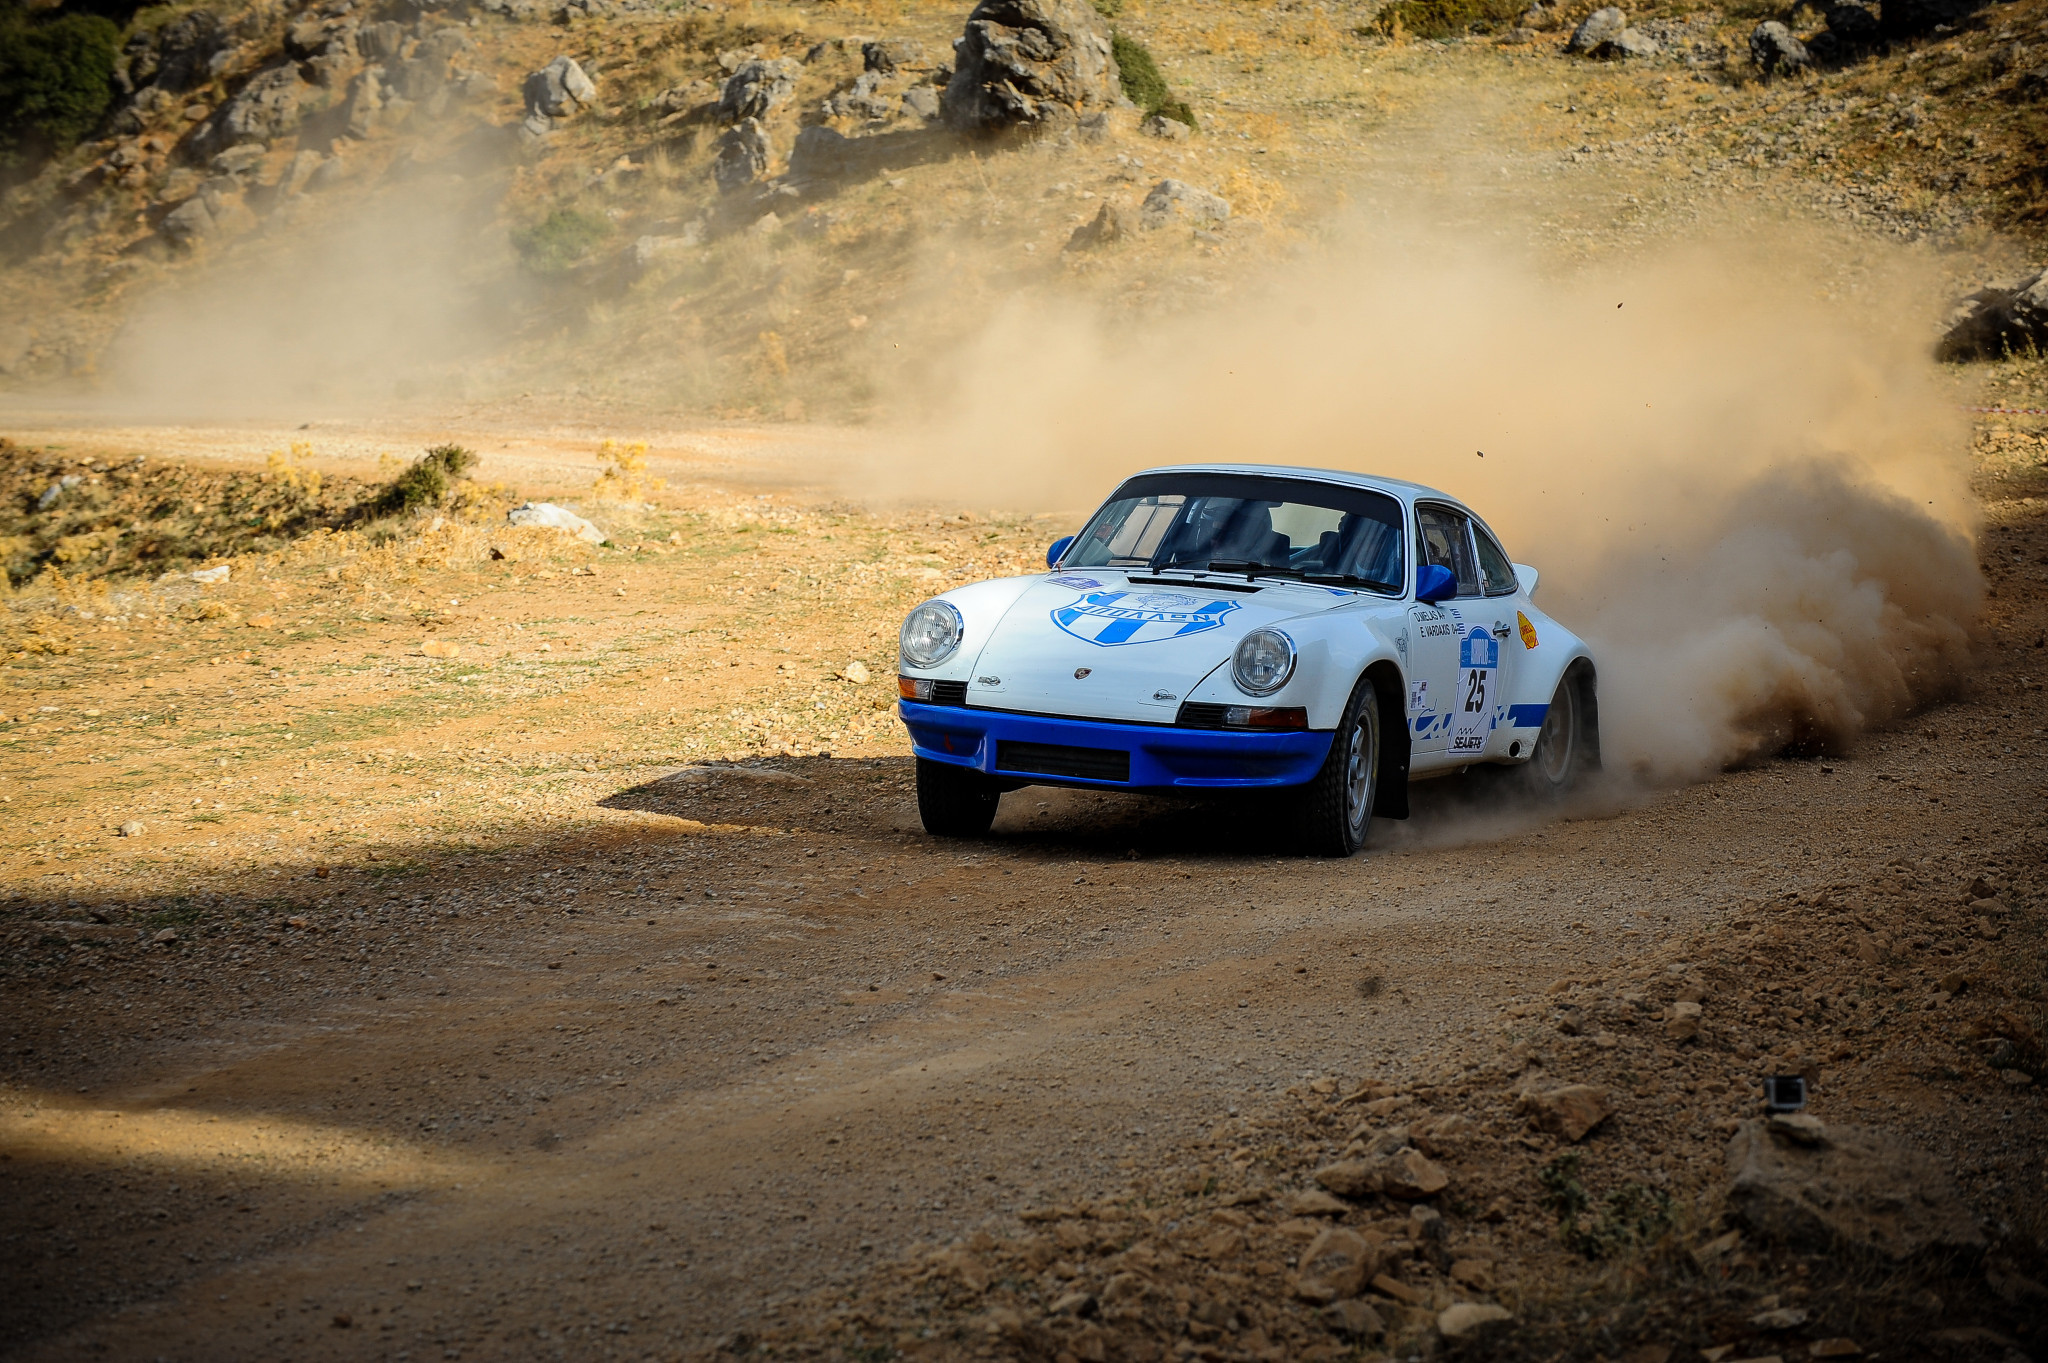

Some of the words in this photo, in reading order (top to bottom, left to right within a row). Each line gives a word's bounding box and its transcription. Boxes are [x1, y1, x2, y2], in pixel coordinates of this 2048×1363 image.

[1425, 624, 1450, 637] VARDAXIS
[1464, 669, 1487, 713] 25
[1453, 736, 1482, 749] SEAJETS
